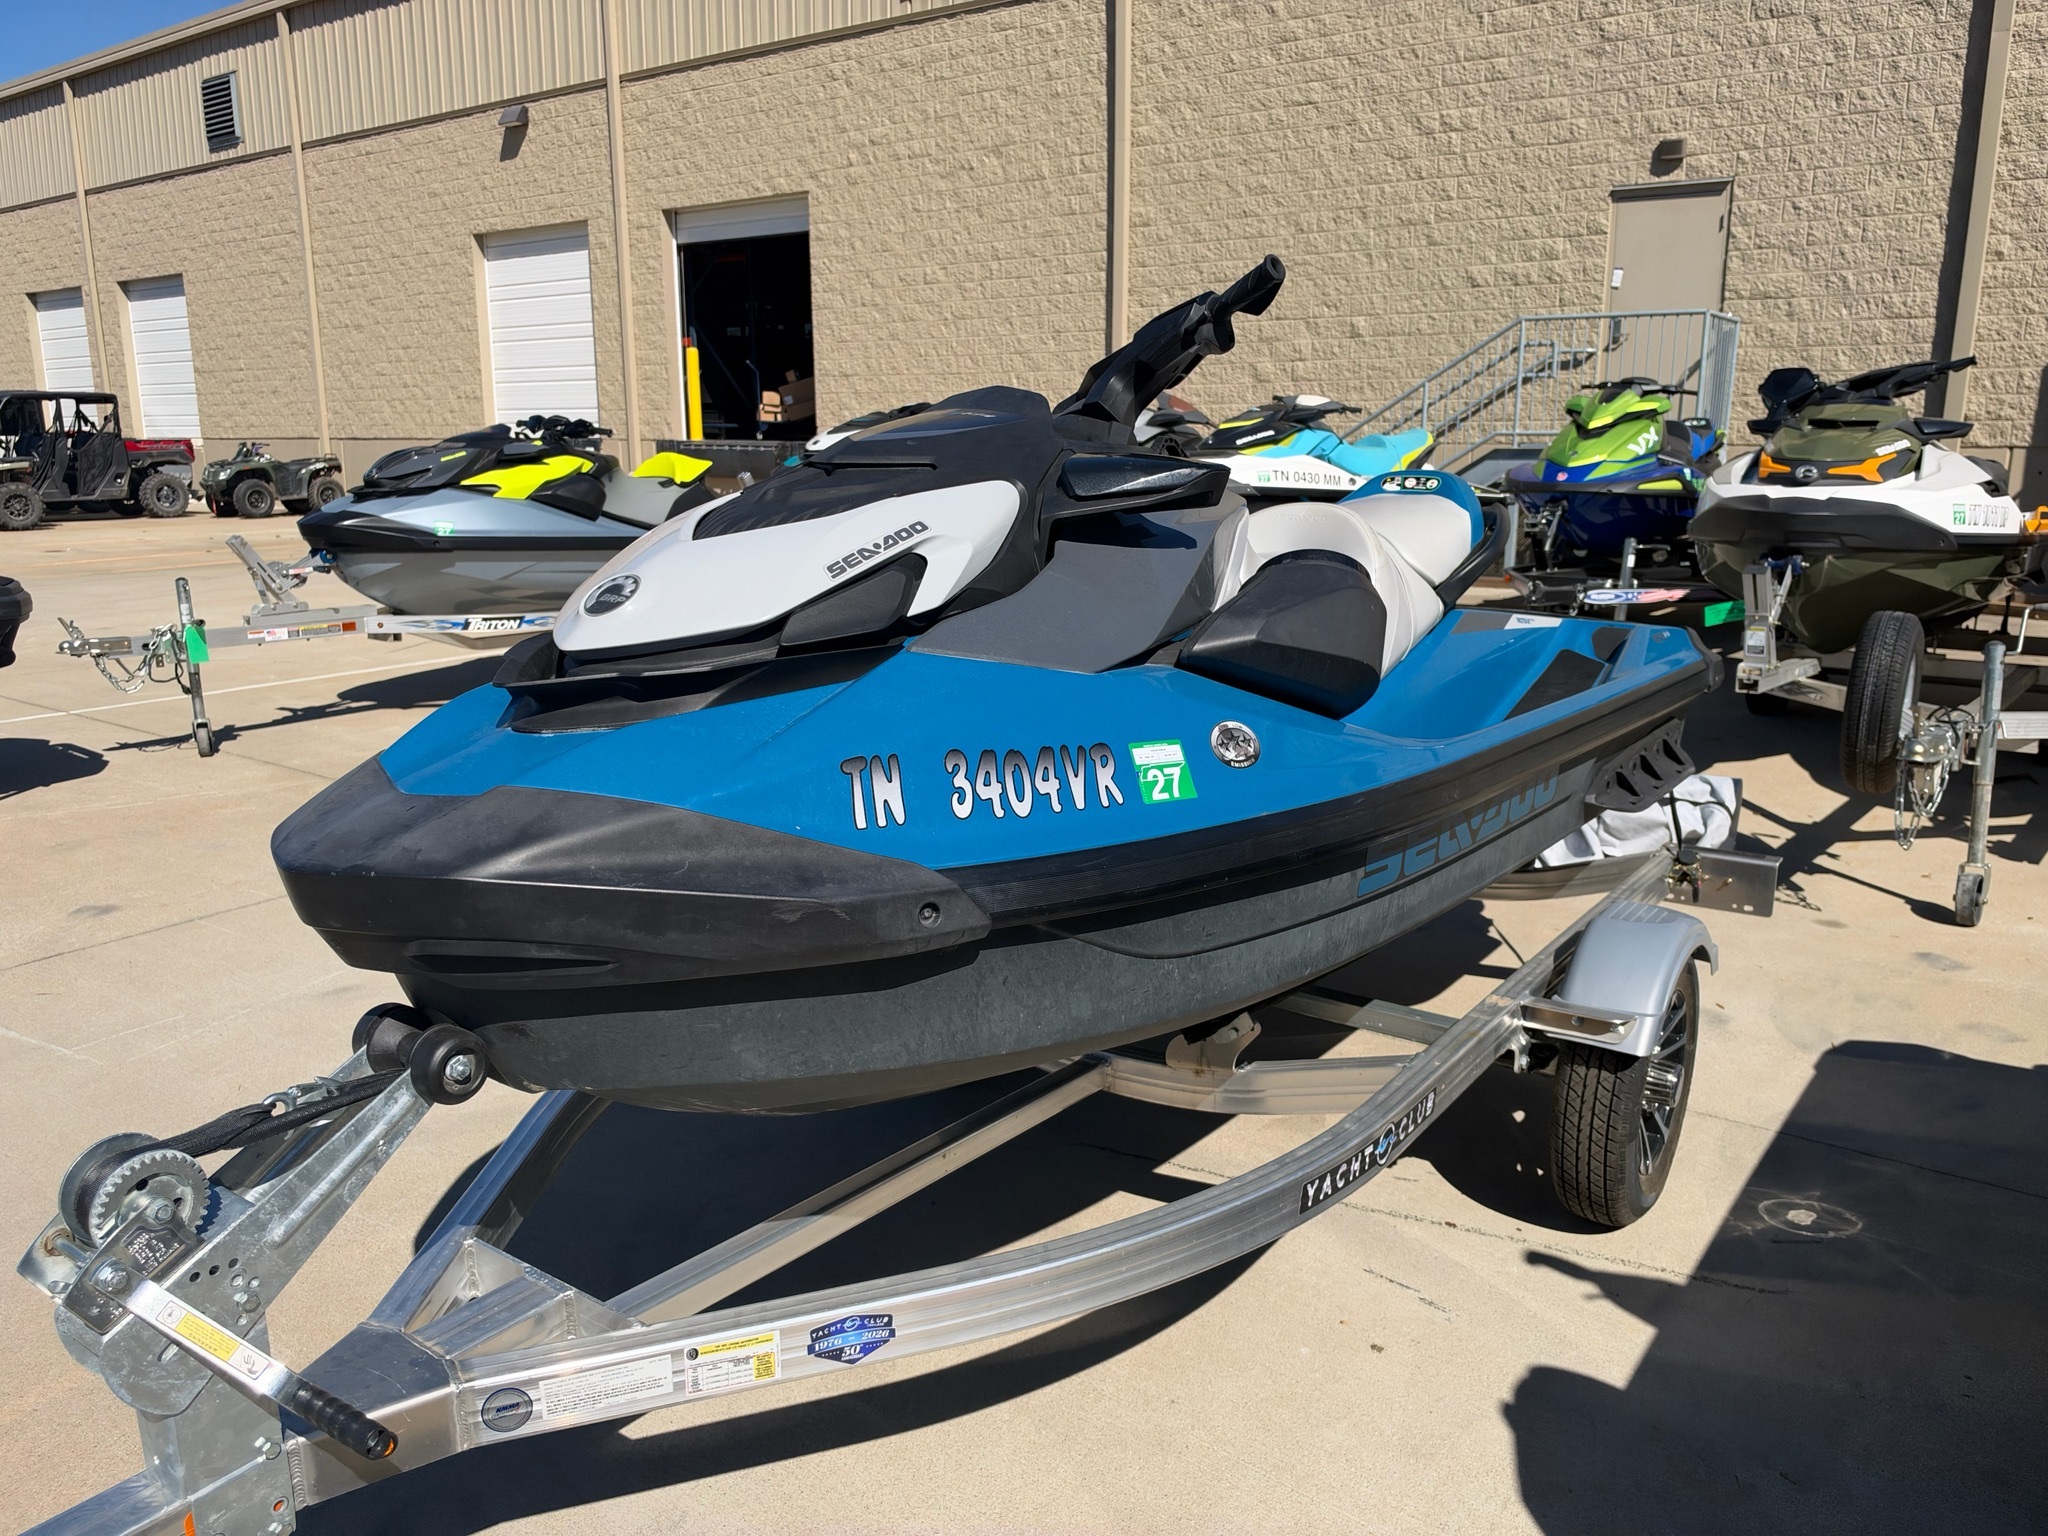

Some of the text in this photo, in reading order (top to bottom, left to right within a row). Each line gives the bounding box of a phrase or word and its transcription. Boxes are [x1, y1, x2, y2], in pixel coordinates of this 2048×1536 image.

[1626, 425, 1659, 456] VX
[1272, 470, 1341, 486] TN 0430 MM
[1954, 511, 1966, 525] 27
[436, 527, 452, 536] 27
[599, 593, 627, 603] BRP
[467, 617, 521, 631] TRITON
[840, 742, 1125, 830] TN 3404VR
[1147, 766, 1182, 801] 27
[1306, 1090, 1436, 1208] YACHT CLUB
[811, 1316, 890, 1340] YACHT CLUB
[813, 1337, 843, 1352] 1976
[861, 1329, 890, 1341] 2026
